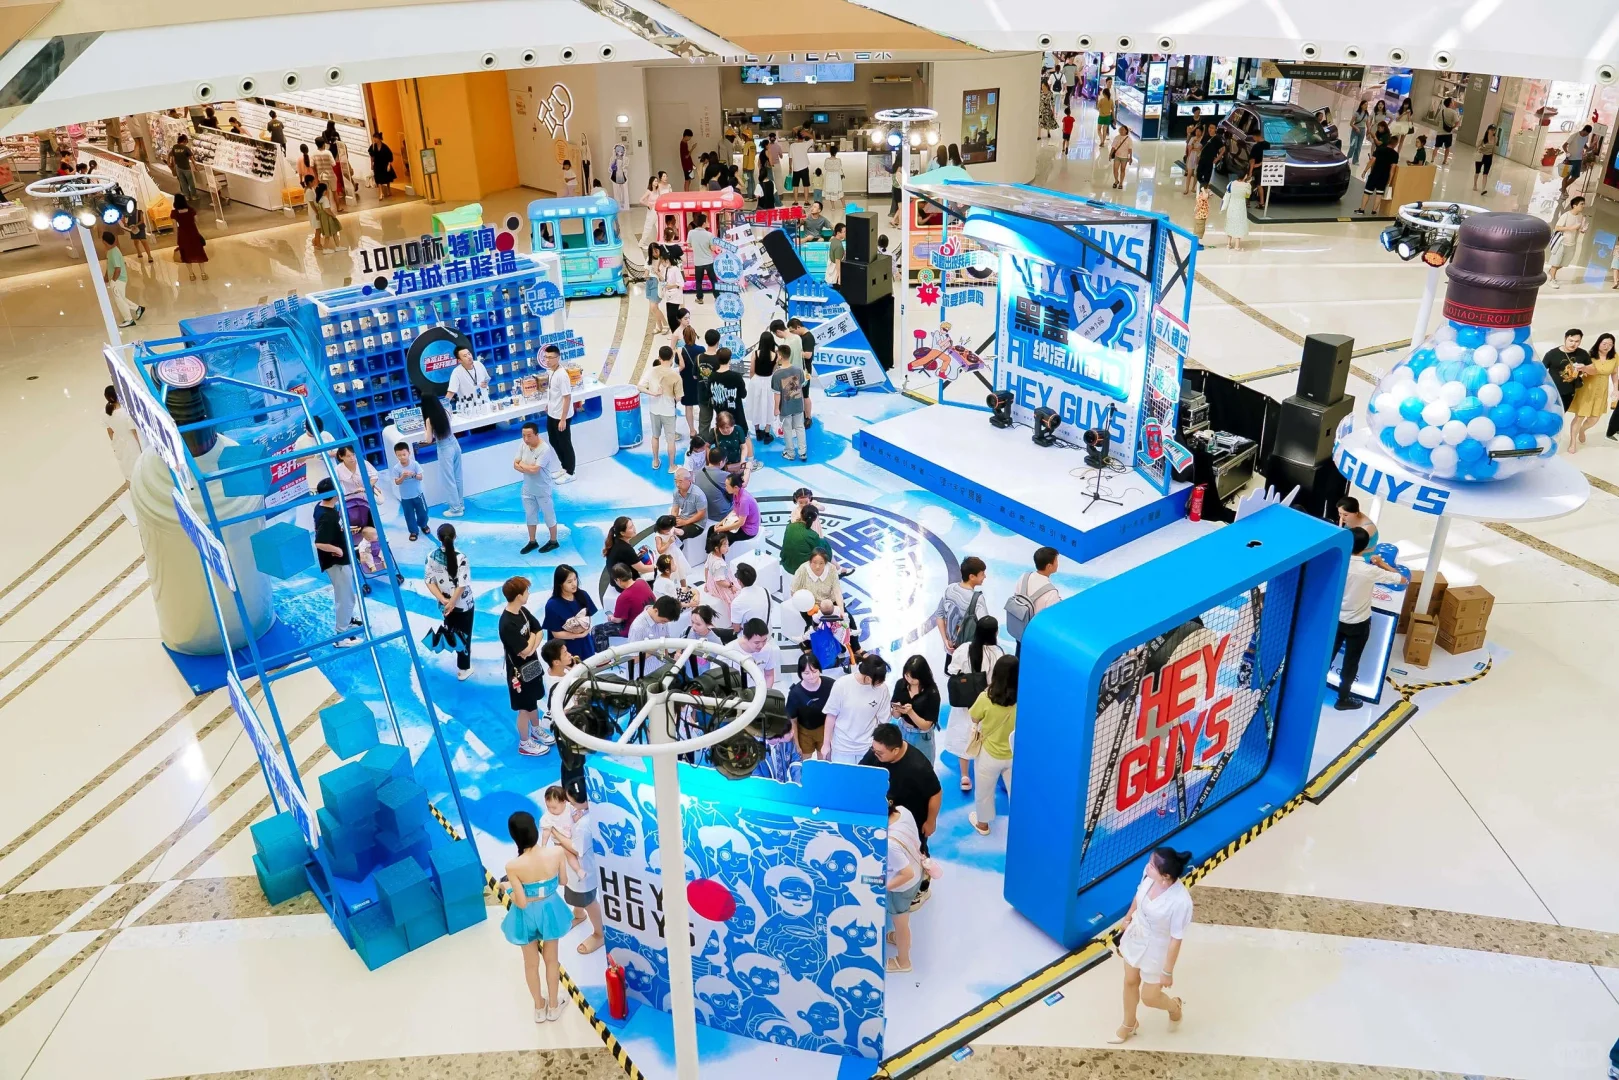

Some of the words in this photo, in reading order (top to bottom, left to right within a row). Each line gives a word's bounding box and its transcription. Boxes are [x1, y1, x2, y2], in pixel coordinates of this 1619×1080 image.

[393, 250, 517, 295] 为城市降温
[814, 352, 834, 364] HEY
[836, 354, 867, 367] GUYS
[1006, 371, 1053, 414] HEY
[1060, 390, 1127, 444] GUYS
[1338, 448, 1451, 516] GUYS
[1136, 632, 1232, 743] HEY
[1115, 694, 1234, 813] GUYS
[600, 865, 663, 912] HEY
